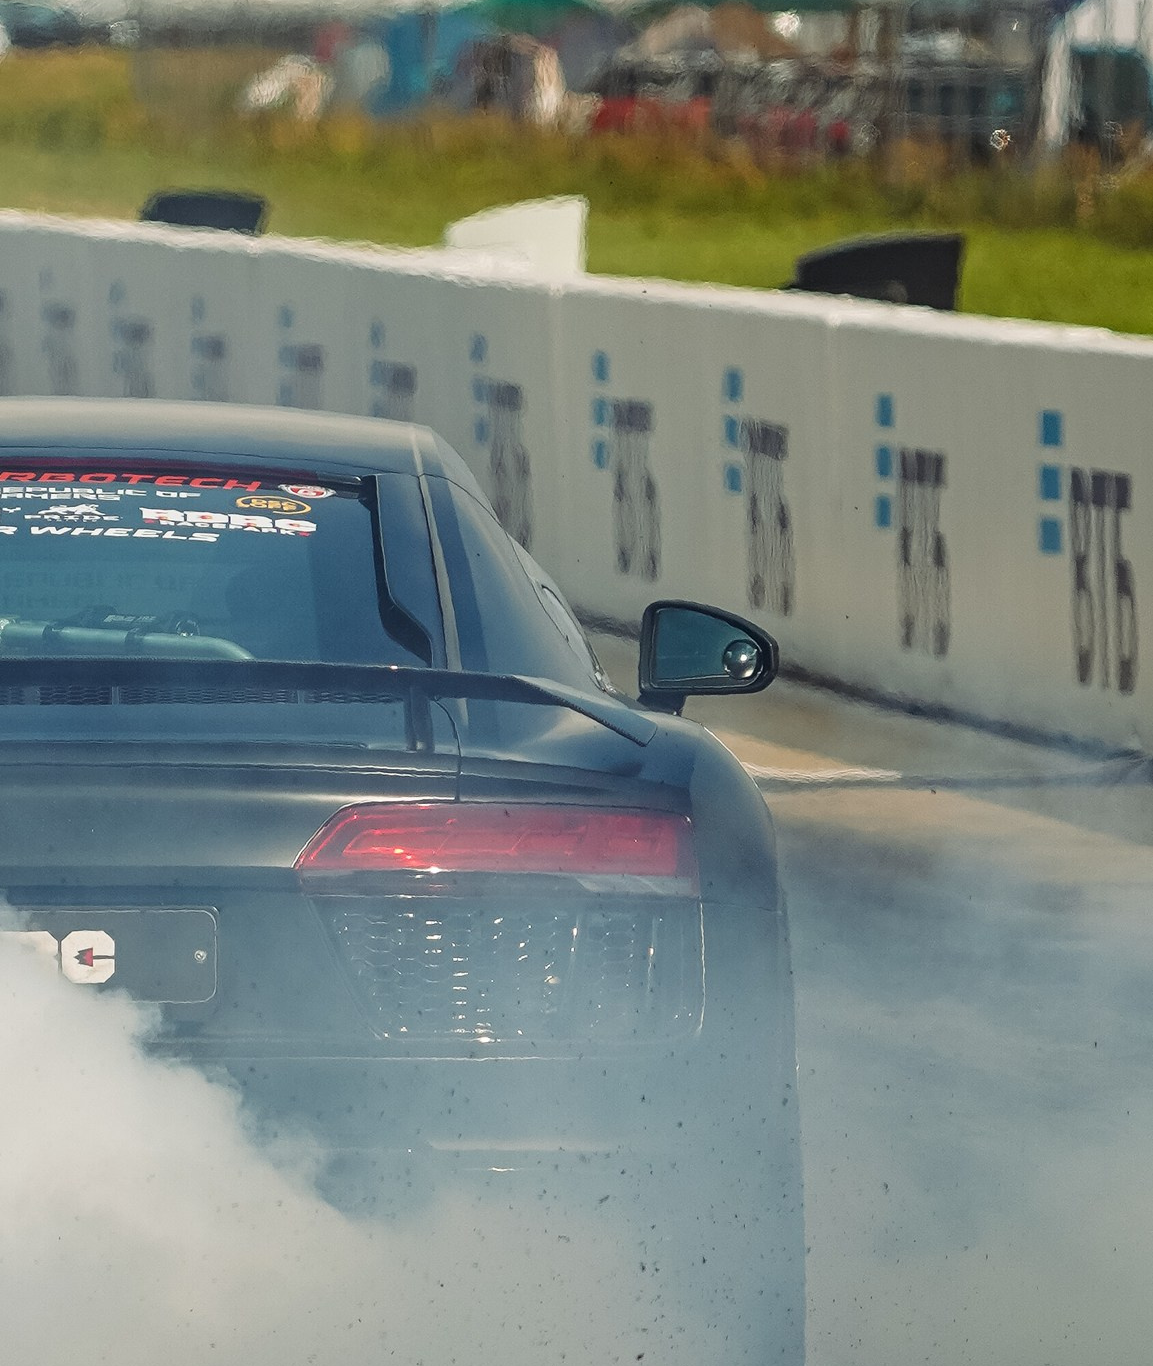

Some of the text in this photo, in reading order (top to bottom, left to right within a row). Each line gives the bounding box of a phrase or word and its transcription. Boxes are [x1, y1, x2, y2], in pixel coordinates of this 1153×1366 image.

[155, 490, 202, 498] OF
[30, 526, 221, 543] WHEELS
[159, 519, 296, 536] RACEPARK
